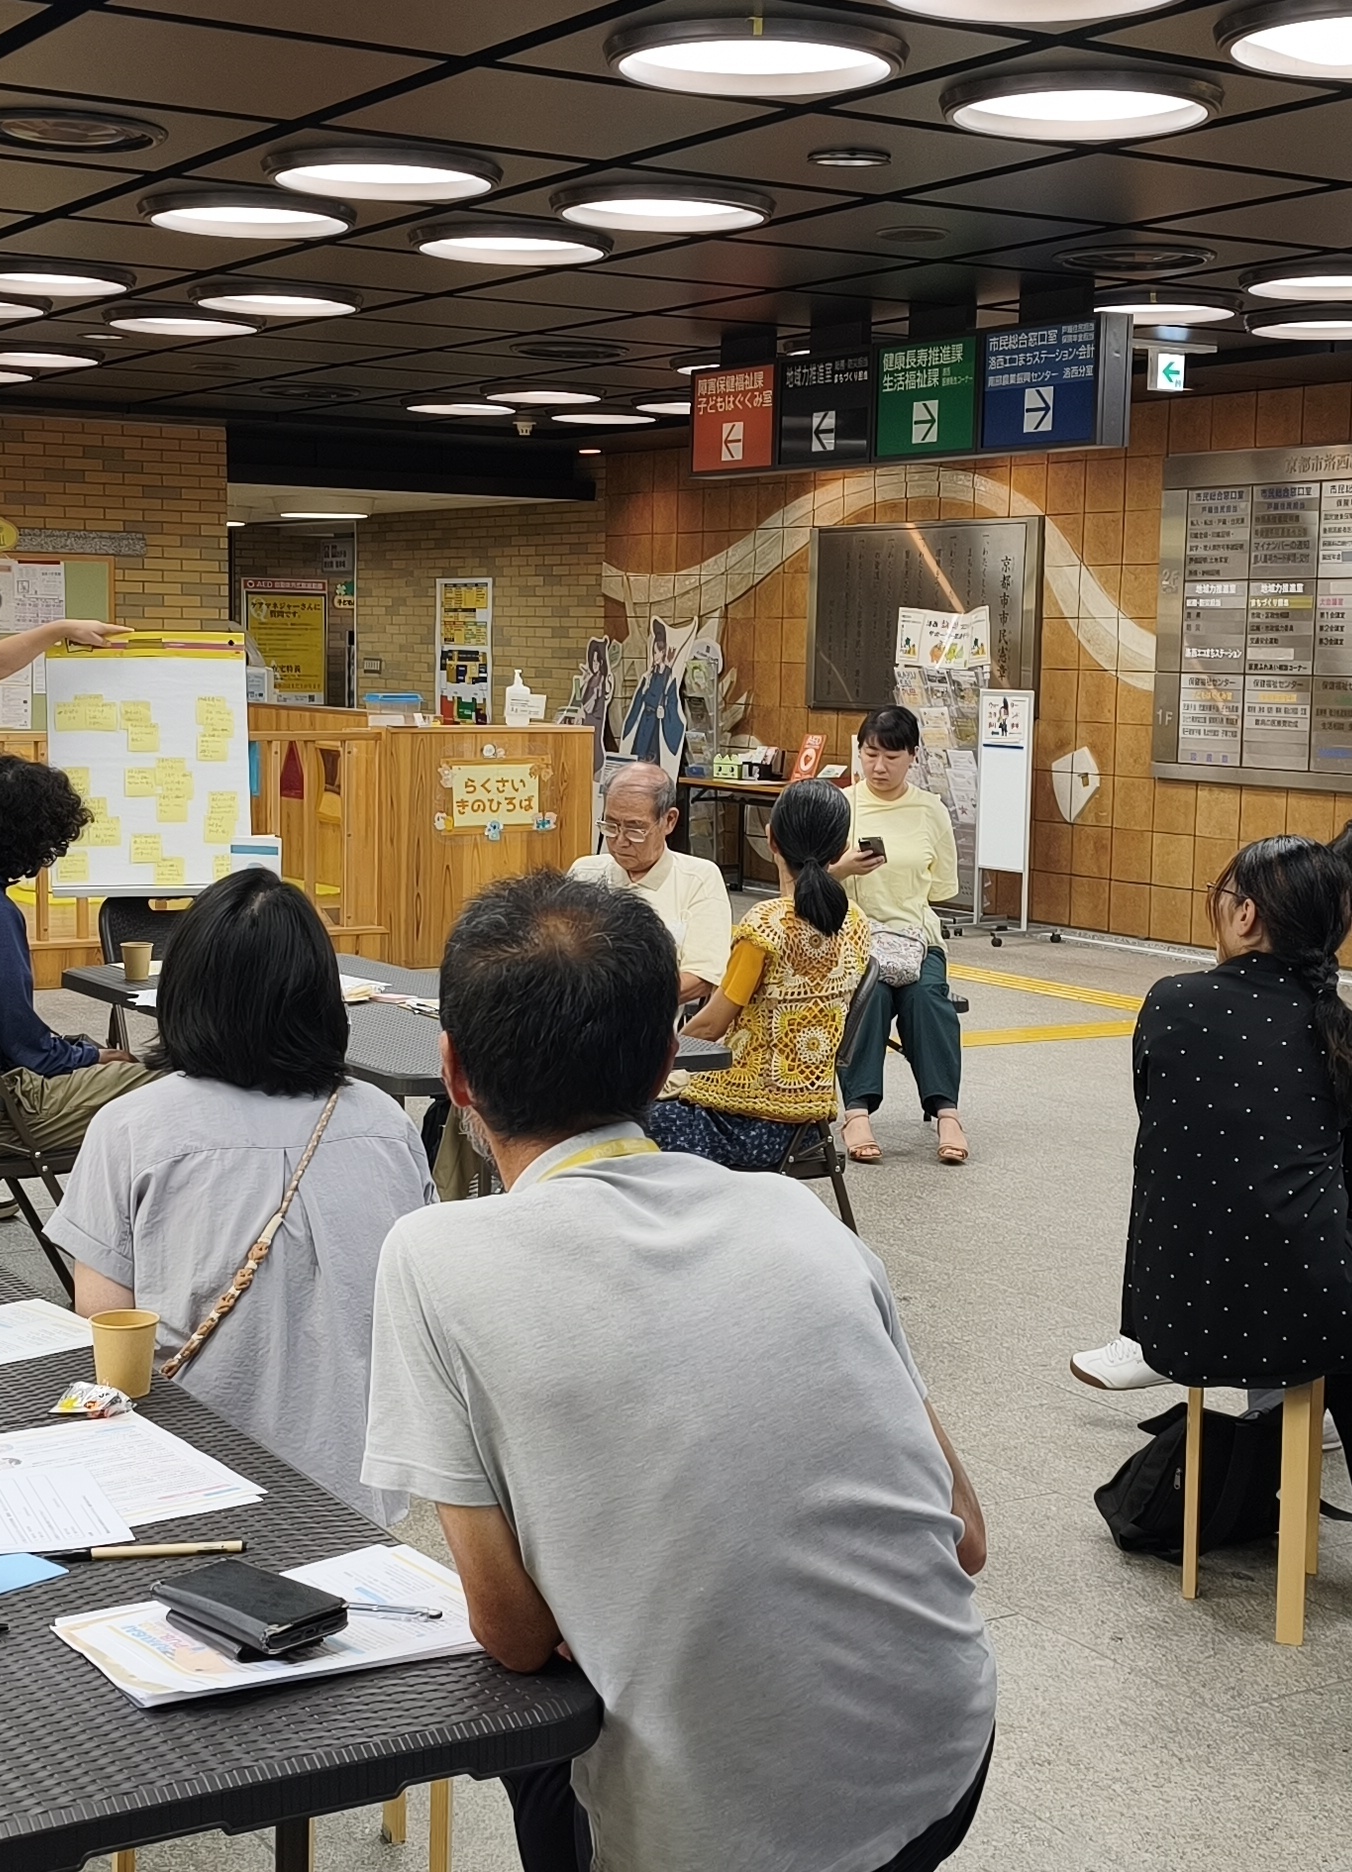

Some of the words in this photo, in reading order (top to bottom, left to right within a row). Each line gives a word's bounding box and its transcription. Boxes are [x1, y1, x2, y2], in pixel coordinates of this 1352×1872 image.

[989, 329, 1058, 352] 市民総合窓口室
[883, 343, 963, 372] 健康長寿推進課
[698, 371, 764, 396] 障害保健福祉課
[786, 362, 833, 388] 地域力推進室
[882, 368, 939, 393] 生活福祉課
[697, 390, 773, 415] 子どもはぐくみ室
[256, 580, 273, 588] AED
[998, 556, 1012, 682] 京都市市民憲章
[1157, 709, 1173, 726] 1F
[465, 777, 526, 794] らくさい
[456, 795, 535, 815] きのひろば
